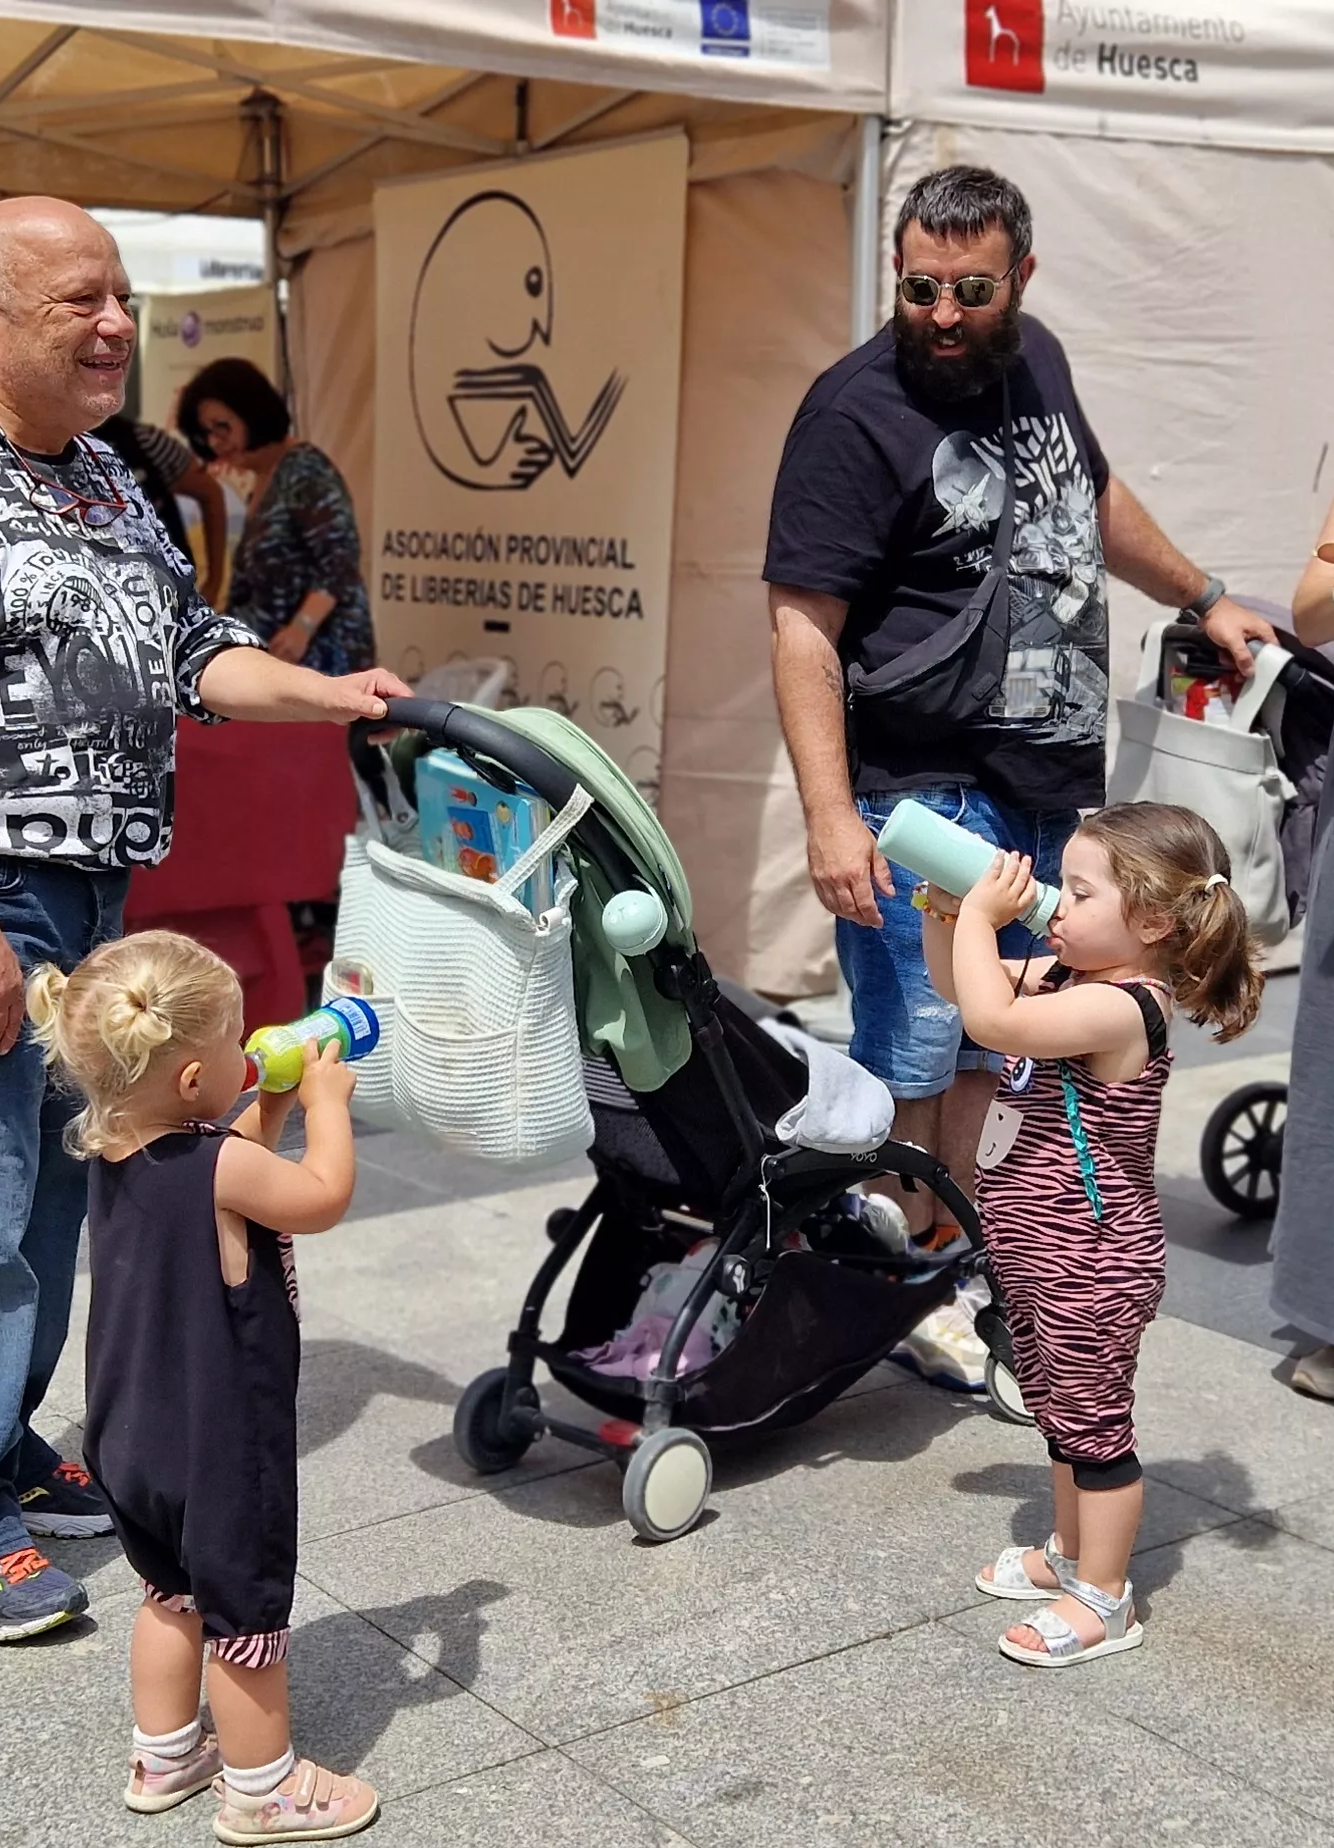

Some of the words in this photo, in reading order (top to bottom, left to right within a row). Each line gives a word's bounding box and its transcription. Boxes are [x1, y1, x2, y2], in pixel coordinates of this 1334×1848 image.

[1057, 0, 1245, 43] Ayuntamiento
[1053, 41, 1086, 72] de
[1097, 43, 1199, 82] Huesca
[383, 527, 501, 563] ASOCIACIÓN
[507, 534, 635, 569] PROVINCIAL
[382, 573, 405, 602] DE
[411, 575, 512, 610] LIBRERIAS
[517, 583, 545, 612] DE
[552, 584, 644, 619] HUESCA
[851, 1152, 878, 1163] YOYO
